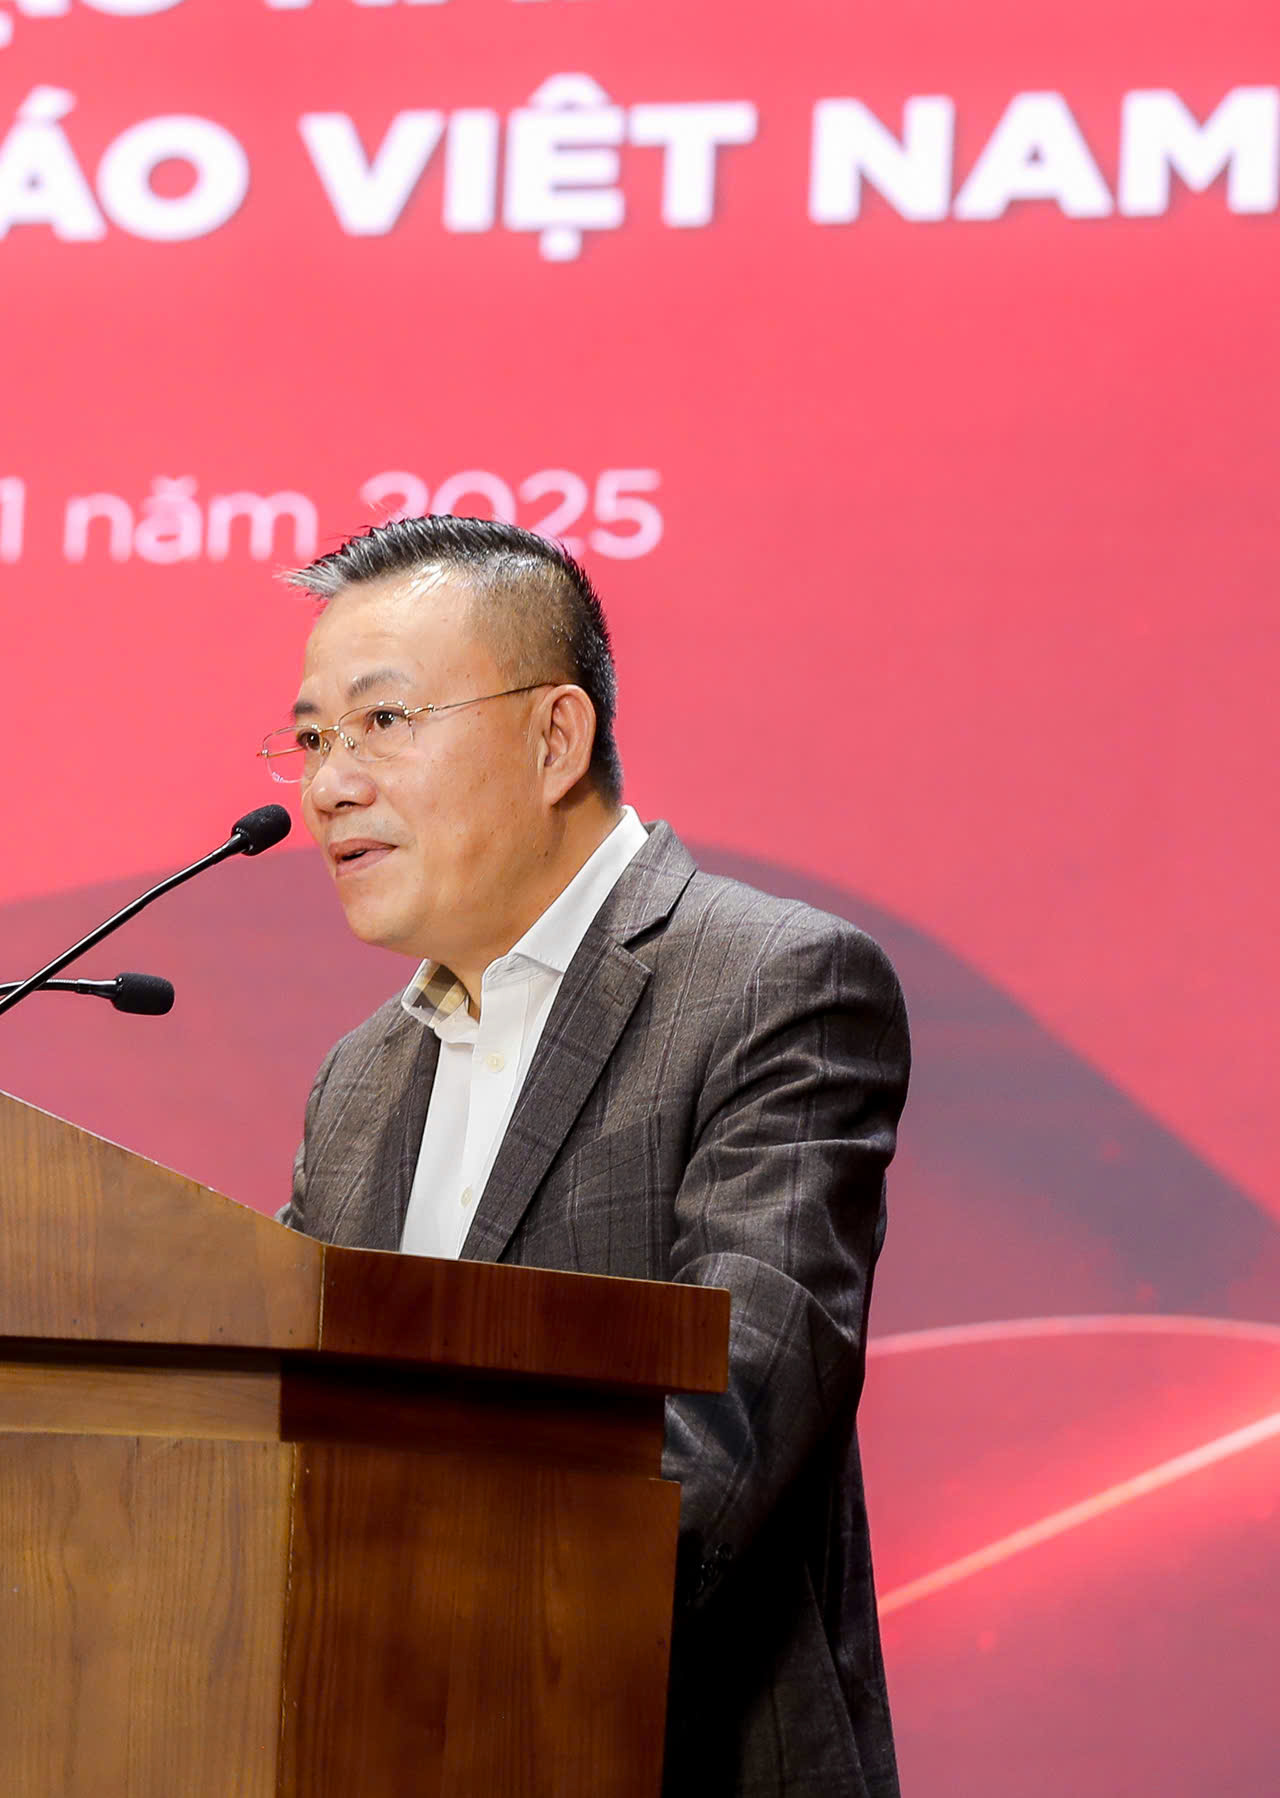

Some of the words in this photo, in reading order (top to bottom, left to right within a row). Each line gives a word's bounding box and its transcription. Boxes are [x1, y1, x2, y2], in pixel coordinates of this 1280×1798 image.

[298, 72, 759, 262] VIỆT
[807, 85, 1280, 225] NAM
[63, 475, 318, 564] năm
